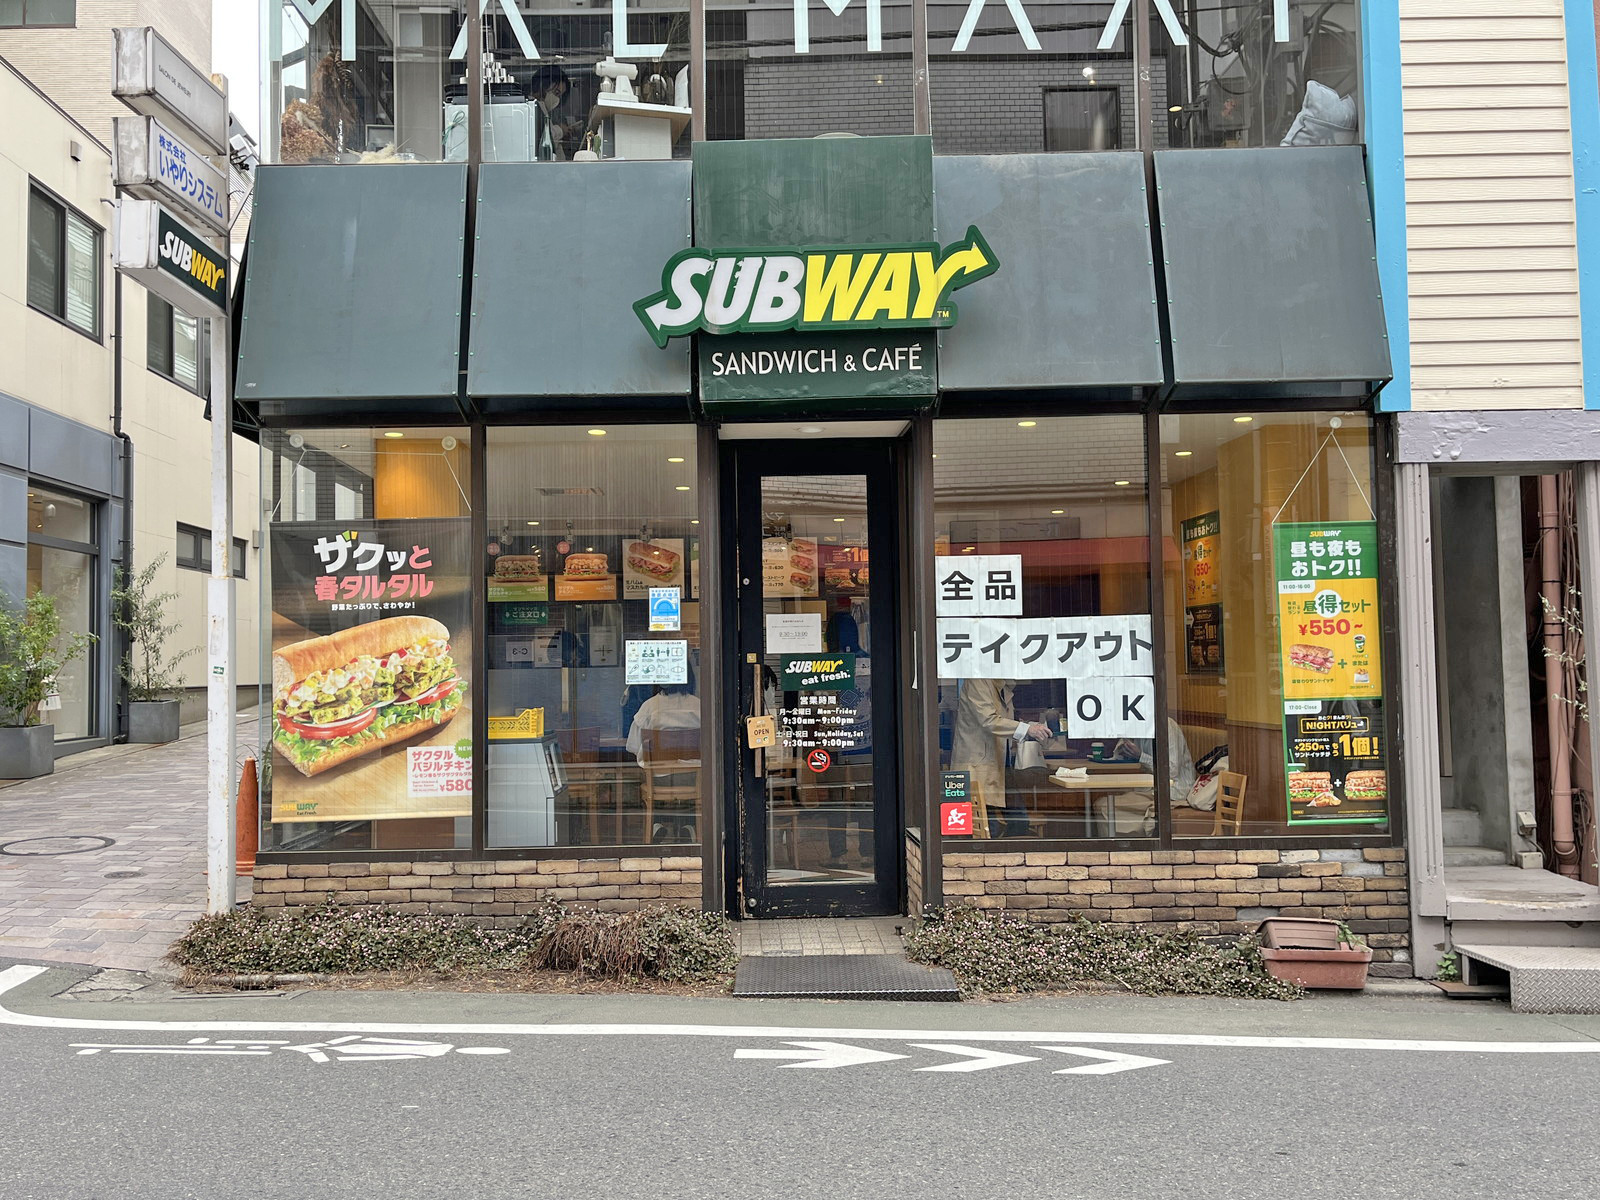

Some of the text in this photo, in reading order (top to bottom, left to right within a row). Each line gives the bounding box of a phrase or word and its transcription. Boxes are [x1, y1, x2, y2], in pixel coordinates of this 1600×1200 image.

[159, 133, 186, 164] 株式会社
[159, 231, 225, 291] SUBWAY
[645, 241, 989, 331] SUBWAY
[711, 343, 923, 376] SANDWICH & CAFÉ
[313, 530, 433, 574] ザクッと
[1290, 540, 1362, 558] 昼も夜も
[1291, 558, 1362, 577] おトク!!
[314, 573, 434, 601] 春タルタル
[941, 570, 1016, 601] 全品
[1303, 594, 1372, 615] 昼得セット
[942, 630, 1153, 665] テイクアウト
[785, 659, 844, 674] SUBWAY
[801, 671, 851, 686] eat fresh.
[800, 695, 837, 705] 営業時間
[1076, 694, 1146, 721] OK
[753, 728, 770, 736] OPEN
[1306, 720, 1365, 730] NIGHTバリュー
[412, 750, 454, 761] ザクタル
[412, 760, 473, 772] バジルチキン
[944, 781, 965, 789] Uber
[945, 789, 965, 797] Eats
